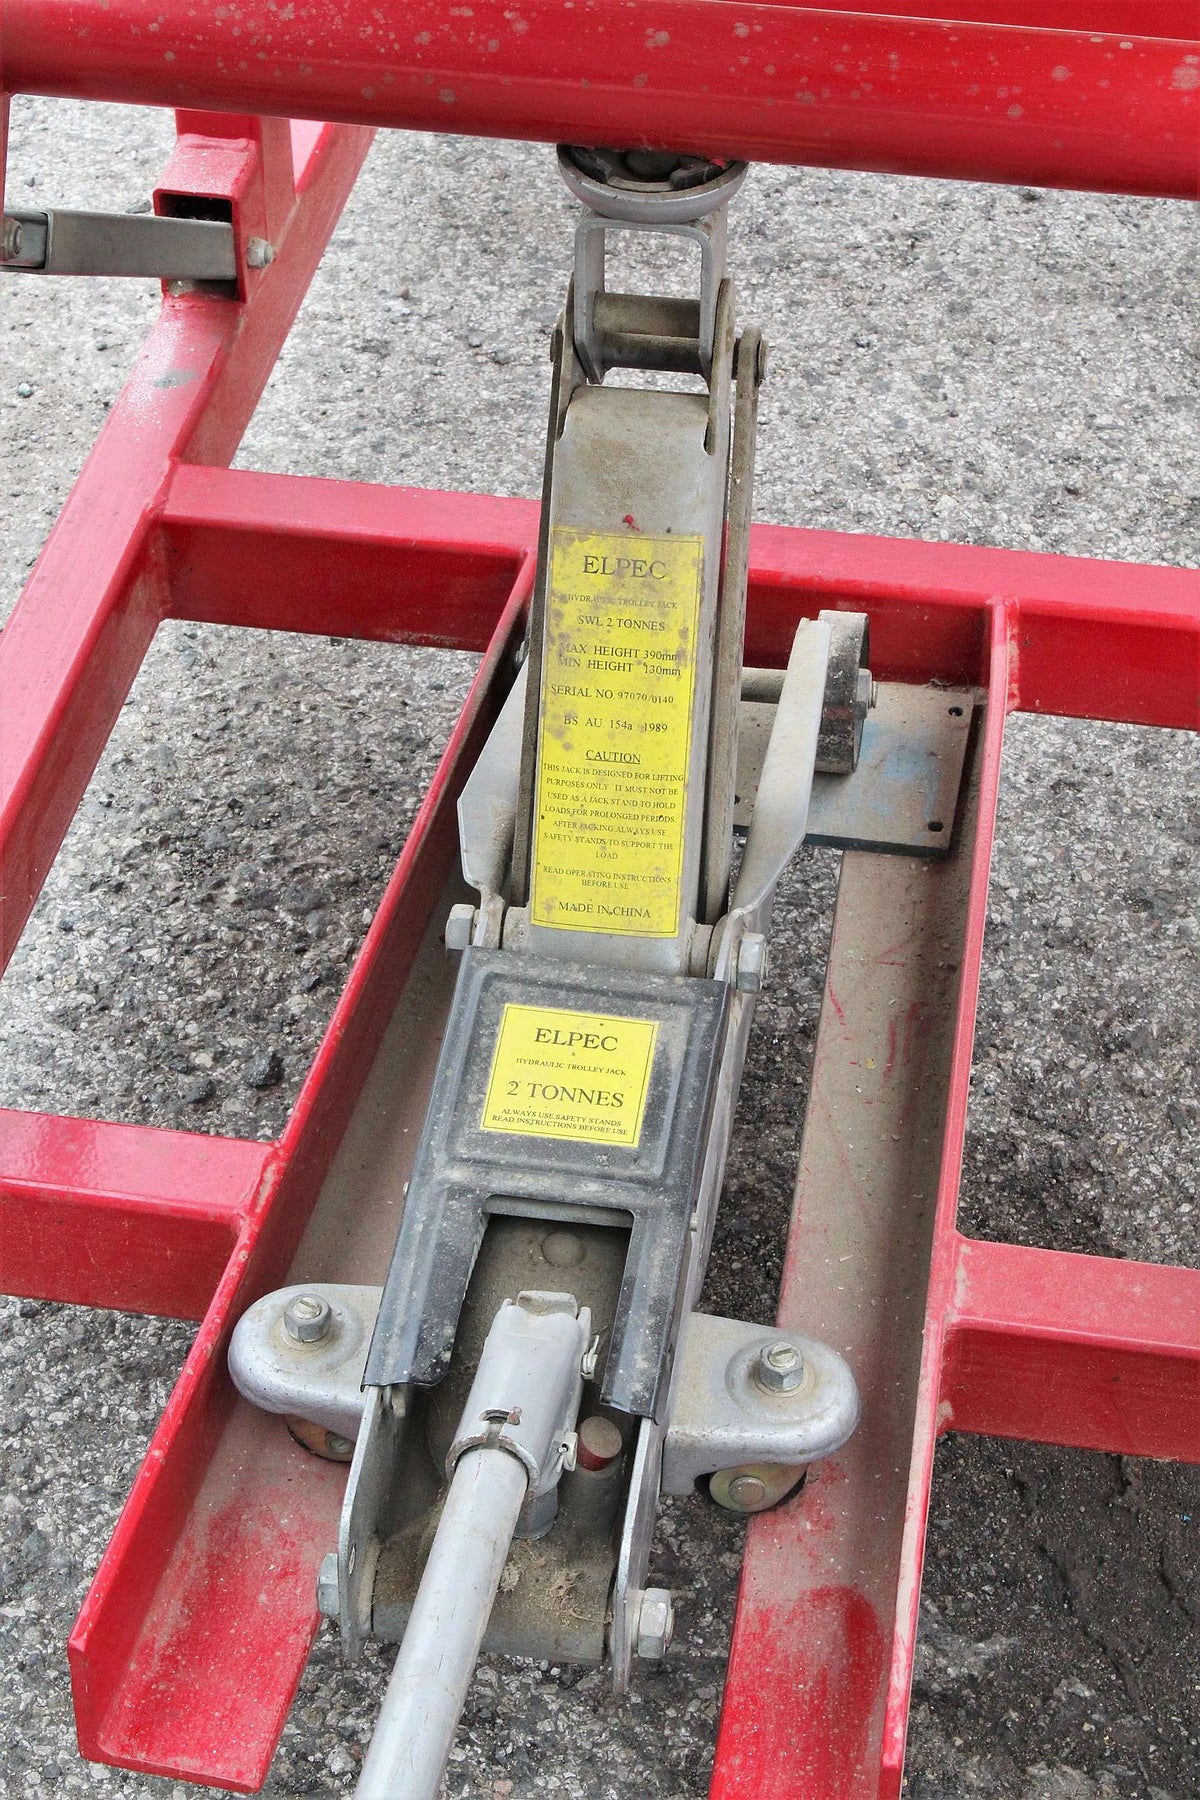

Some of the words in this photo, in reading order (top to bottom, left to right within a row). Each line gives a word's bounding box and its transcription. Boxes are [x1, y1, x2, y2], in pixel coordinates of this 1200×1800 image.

[583, 555, 666, 579] ELPEC
[618, 598, 655, 607] TROLLEY
[657, 601, 677, 609] JACK
[578, 615, 602, 626] SWL
[606, 618, 612, 627] 2
[617, 618, 665, 631] TONNES
[560, 643, 586, 653] MAX
[594, 646, 640, 658] HEIGHT
[558, 657, 580, 666] MIN
[588, 660, 633, 672] HEIGHT
[644, 664, 681, 676] 130mm
[551, 684, 591, 697] SERIAL
[596, 689, 613, 698] NO
[564, 717, 578, 725] BS
[585, 719, 601, 727] AU
[610, 720, 633, 730] 154a
[643, 723, 668, 732] 1989
[586, 750, 640, 764] CAUTION
[543, 763, 559, 772] THIS
[562, 766, 580, 774] JACK
[592, 769, 632, 779] DESIGNED
[546, 778, 584, 788] PURPOSES
[587, 781, 608, 790] ONLY
[625, 785, 647, 793] MUST
[548, 792, 568, 800] USED
[589, 796, 609, 804] JACK
[611, 799, 638, 807] STAND
[545, 805, 570, 814] LOADS
[590, 810, 639, 820] PROLONGED
[616, 826, 650, 835] ALWAYS
[544, 832, 572, 842] SAFETY
[575, 836, 606, 845] STANDS
[621, 840, 656, 849] SUPPORT
[543, 866, 564, 875] READ
[566, 869, 611, 879] OPERATING
[613, 874, 671, 883] INSTRUCTIONS
[582, 880, 612, 888] BEFORE
[559, 901, 593, 912] MADE
[597, 905, 609, 914] IN
[613, 907, 651, 918] CHINA
[534, 1028, 618, 1051] ELPEC
[516, 1058, 564, 1068] HYDRAULIC
[567, 1063, 604, 1073] TROLLEY
[606, 1068, 626, 1076] JACK
[507, 1081, 519, 1096] 2
[528, 1083, 624, 1108] TONNES
[492, 1115, 514, 1123] READ
[516, 1118, 577, 1129] INSTRUCTIONS
[579, 1125, 610, 1134] BEFORE
[502, 1108, 536, 1117] ALWAYS
[538, 1111, 554, 1119] USE
[555, 1114, 587, 1123] SAFETY
[589, 1118, 622, 1126] STANDS
